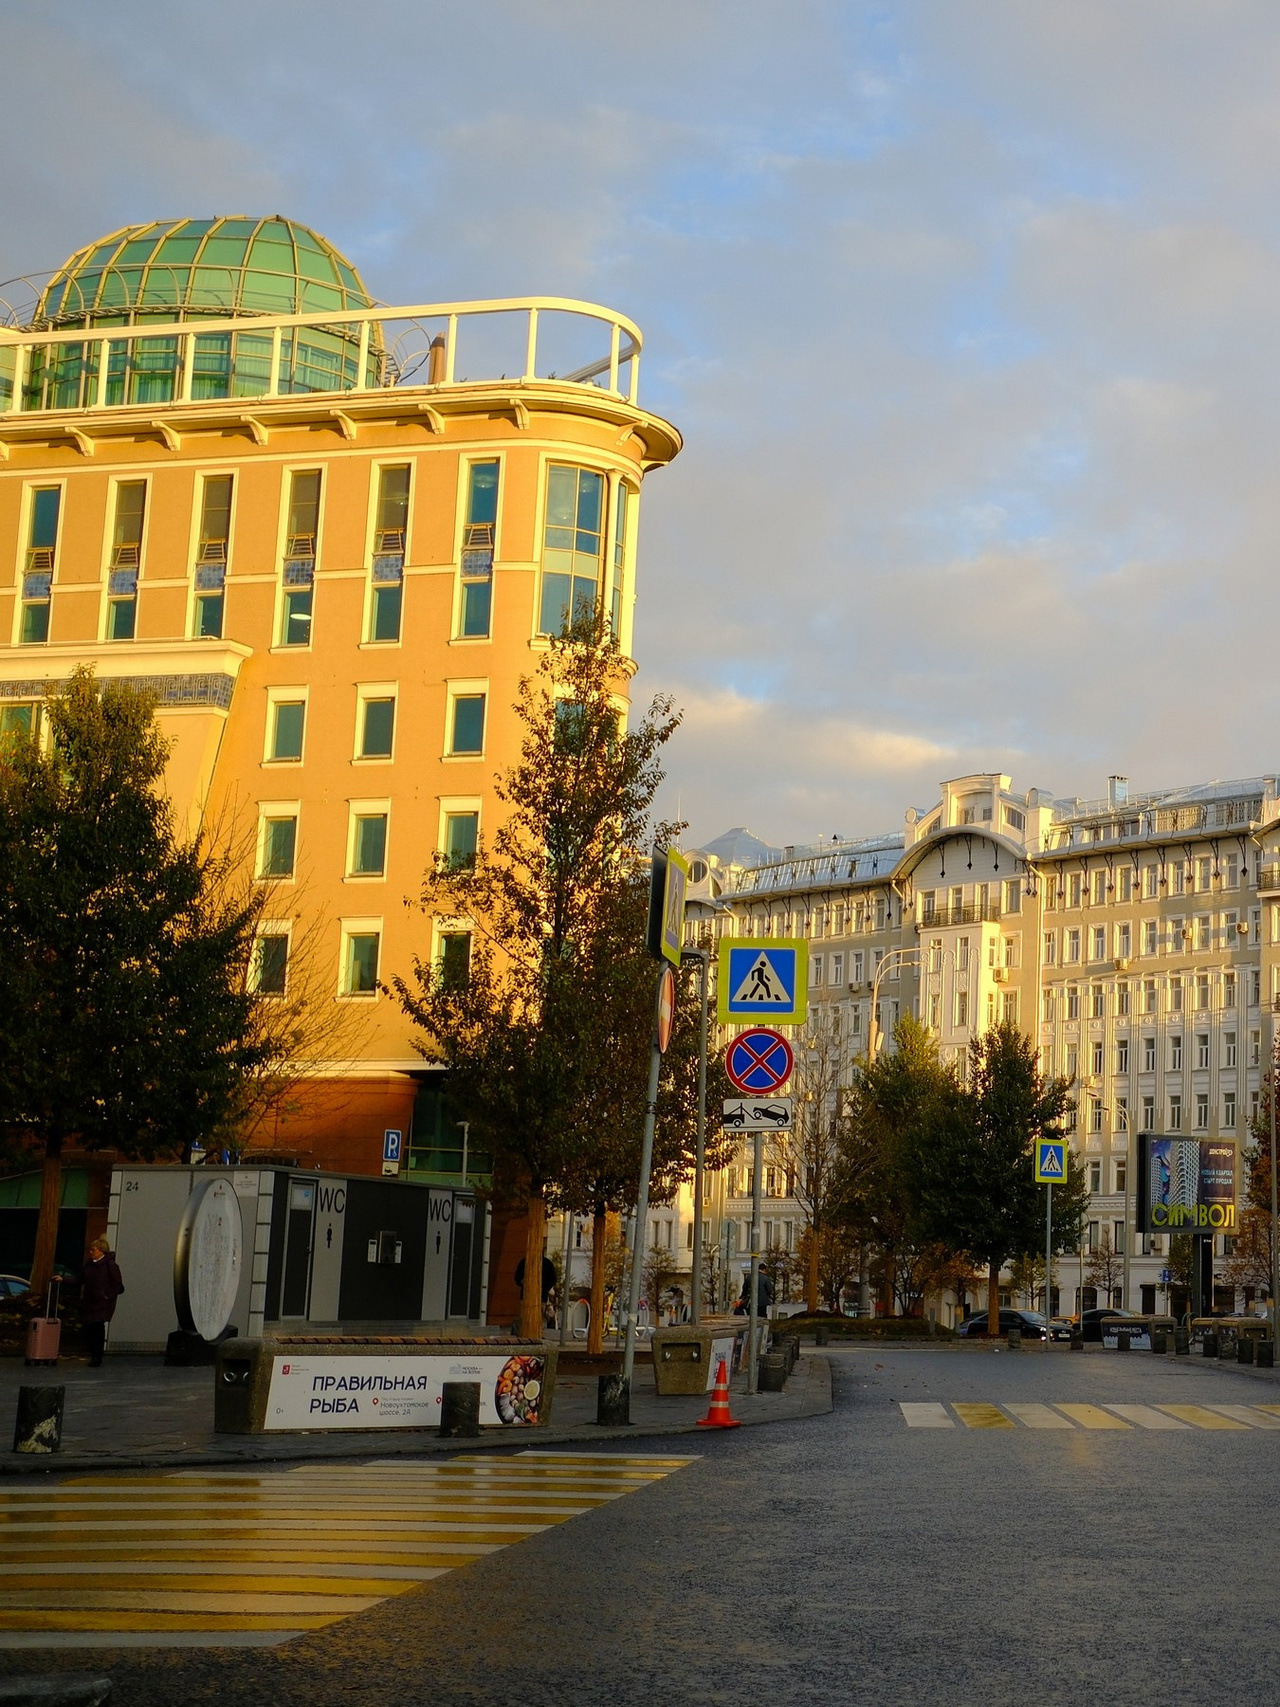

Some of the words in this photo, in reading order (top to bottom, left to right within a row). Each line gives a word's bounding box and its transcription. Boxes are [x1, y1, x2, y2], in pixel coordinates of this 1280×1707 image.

[388, 1133, 398, 1158] P
[125, 1181, 140, 1192] 24
[319, 1187, 346, 1214] WC
[429, 1198, 451, 1222] WC
[1151, 1203, 1235, 1227] СИМВОЛ
[312, 1375, 428, 1391] ПРАВИЛЬНАЯ
[309, 1398, 359, 1413] РЫБА
[380, 1401, 430, 1409] Новоухтомское
